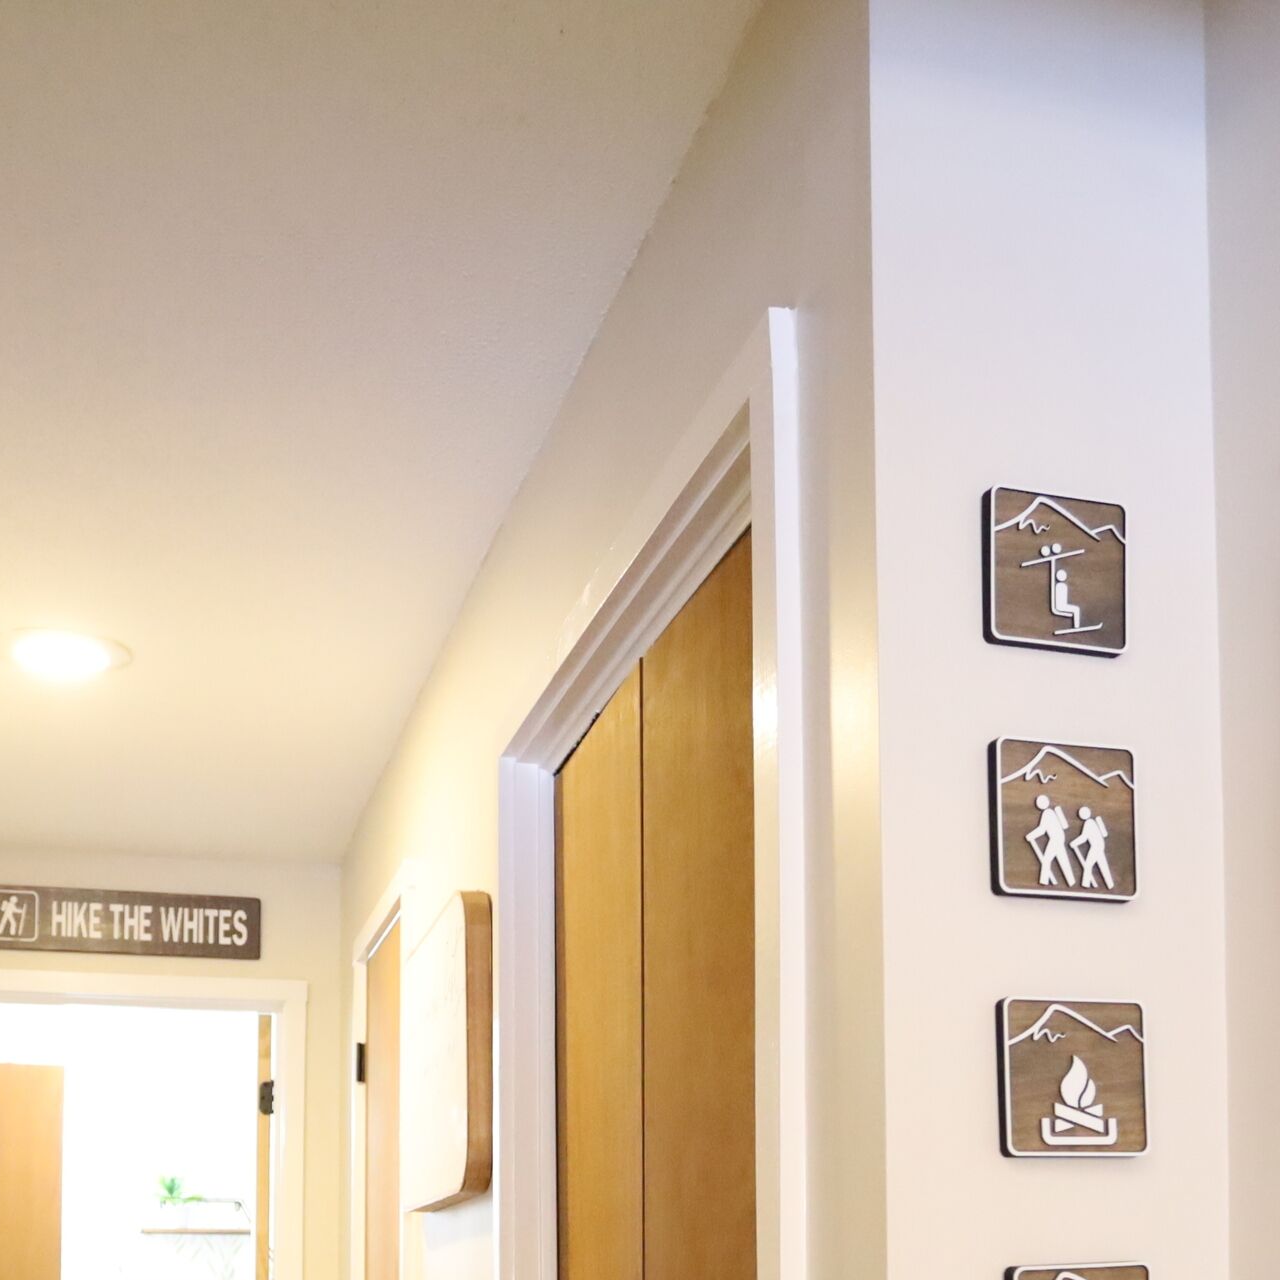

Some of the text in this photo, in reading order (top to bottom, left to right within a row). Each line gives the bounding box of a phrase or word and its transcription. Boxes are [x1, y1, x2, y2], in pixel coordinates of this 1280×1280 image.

[50, 901, 249, 947] HIKE THE WHITES
